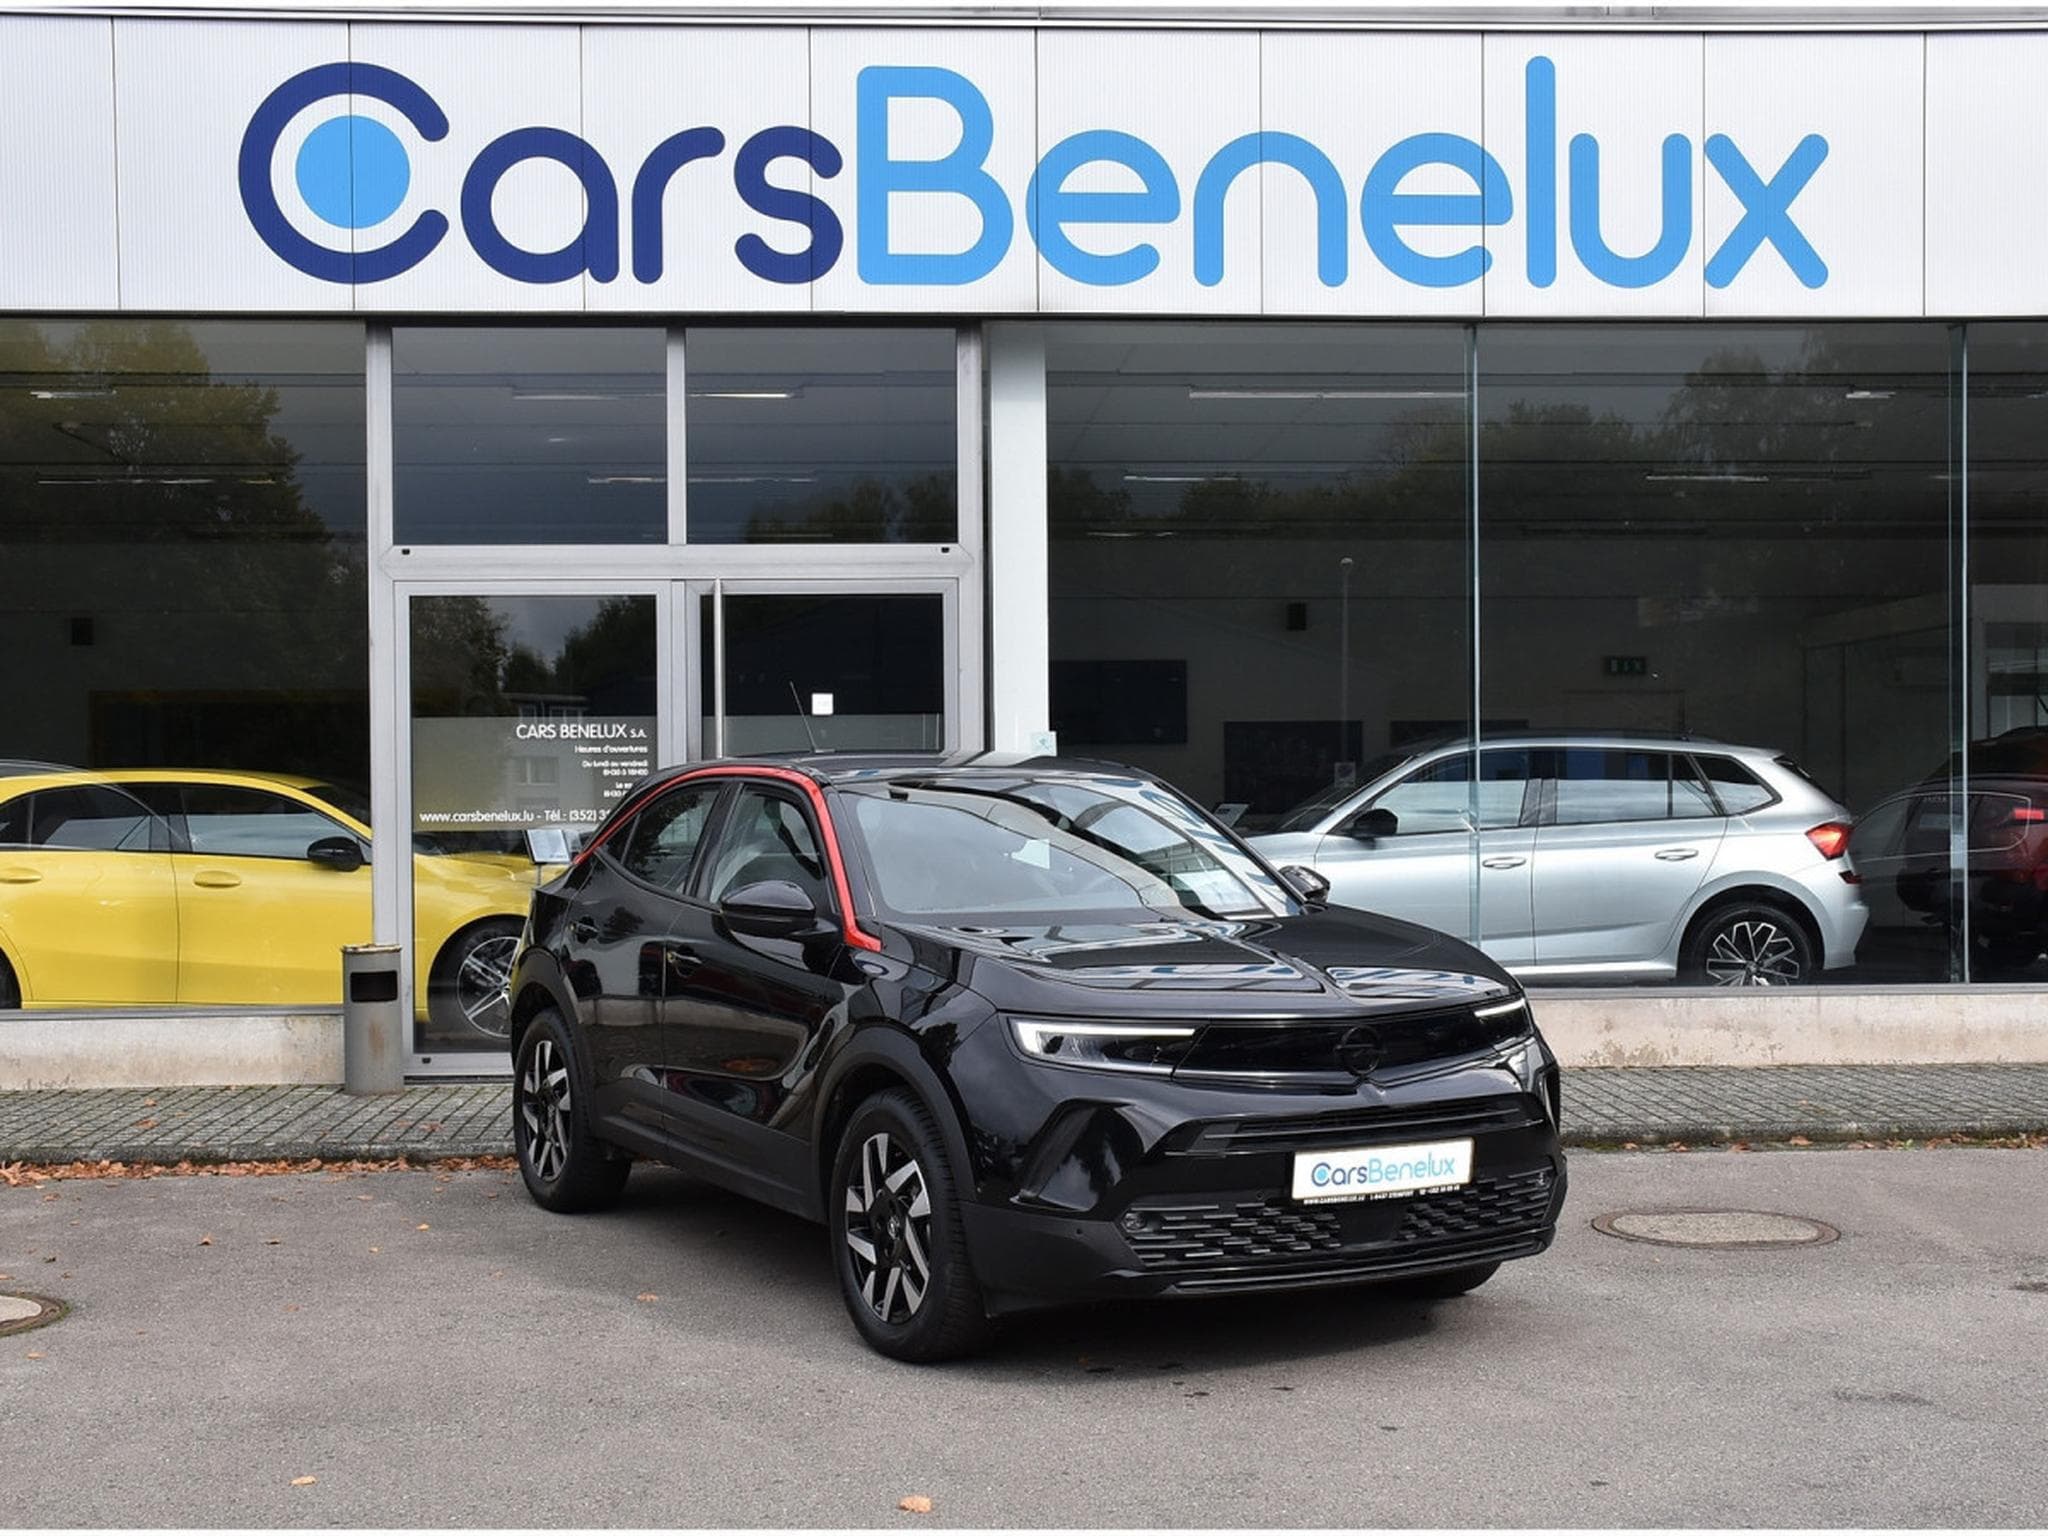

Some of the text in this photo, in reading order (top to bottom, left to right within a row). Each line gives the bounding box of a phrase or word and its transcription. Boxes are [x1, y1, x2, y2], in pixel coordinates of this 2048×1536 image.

[238, 55, 1829, 289] CarsBenelux
[516, 724, 557, 739] CARS
[560, 724, 627, 739] BENELUX
[419, 809, 534, 823] www.carsbenelux.lu
[1311, 1152, 1456, 1187] CarsBenelux
